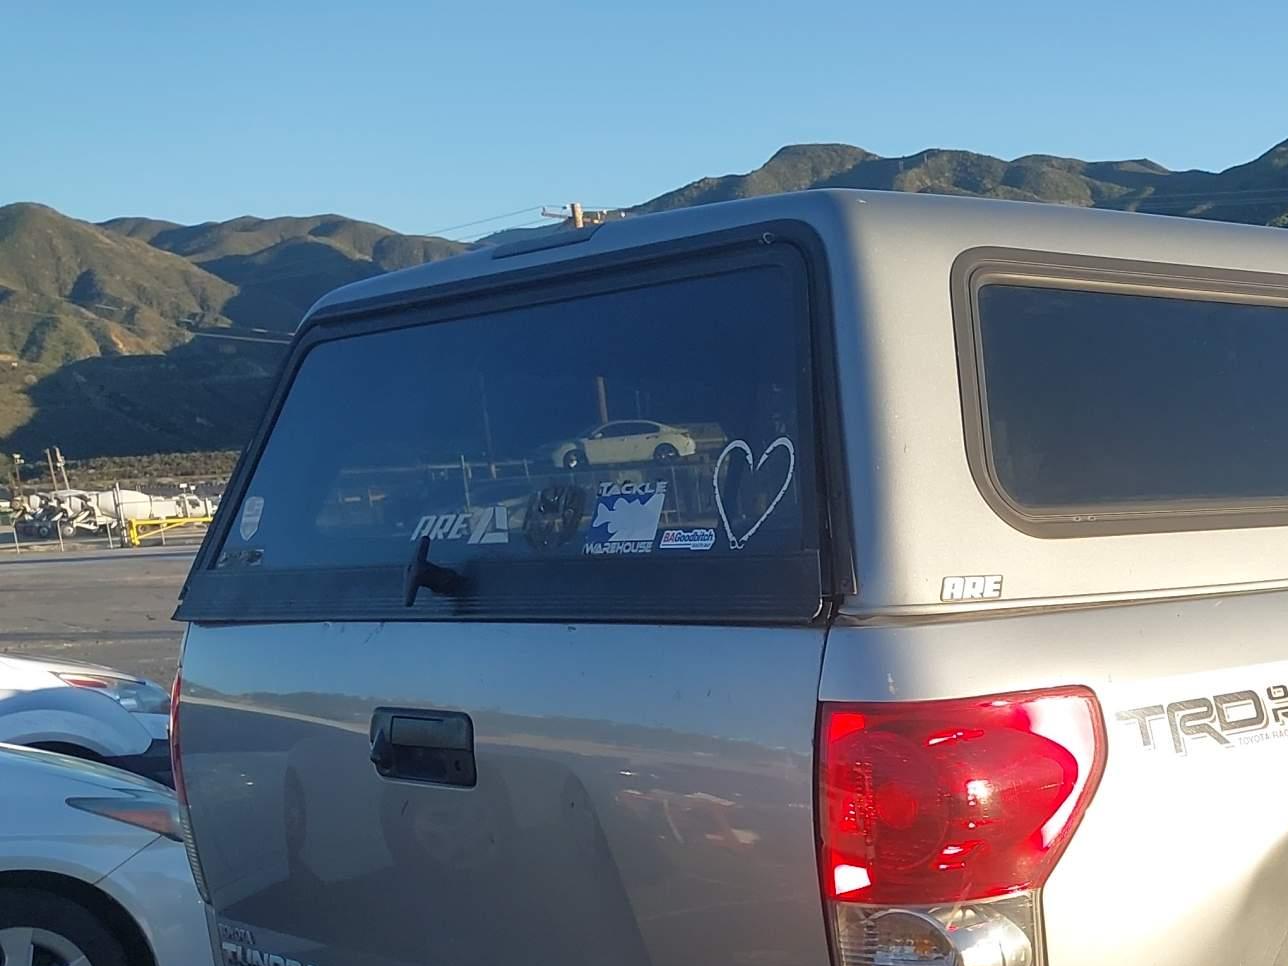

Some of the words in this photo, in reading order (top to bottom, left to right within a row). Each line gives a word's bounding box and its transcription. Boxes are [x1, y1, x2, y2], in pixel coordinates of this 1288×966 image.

[600, 481, 668, 497] TACKLE
[410, 512, 472, 541] ARE
[583, 541, 654, 555] WAREHOUSE
[941, 574, 1003, 601] ARE
[1115, 689, 1269, 758] TRD
[1238, 733, 1270, 746] TOYOTA
[217, 923, 256, 945] TOYOTA
